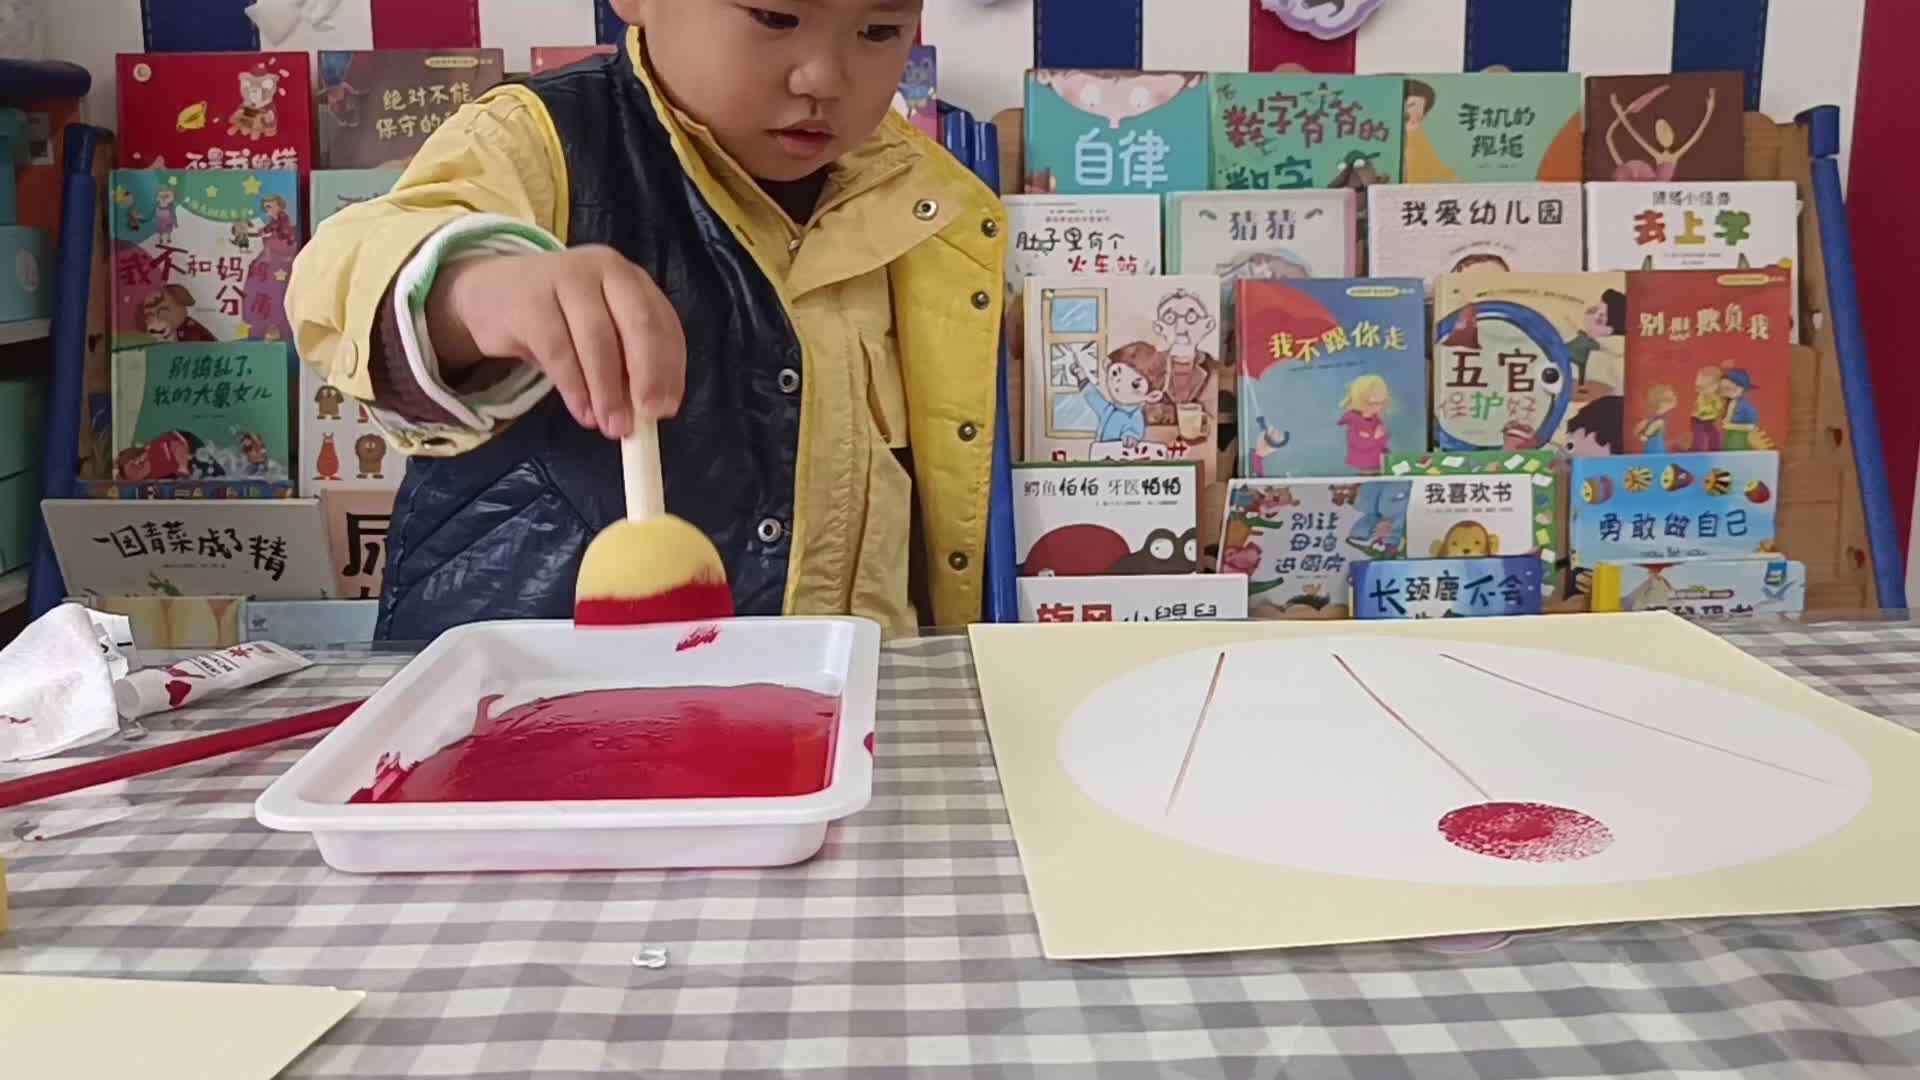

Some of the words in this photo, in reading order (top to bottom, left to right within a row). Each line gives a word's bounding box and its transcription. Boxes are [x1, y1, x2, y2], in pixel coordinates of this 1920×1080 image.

[383, 81, 473, 111] 绝对不能
[376, 113, 453, 139] 保守的
[1222, 91, 1391, 149] 数字爷爷的
[1457, 102, 1536, 131] 手机的
[1074, 128, 1170, 188] 自律
[1471, 133, 1524, 158] 规矩
[1229, 210, 1296, 241] 猜猜
[1401, 199, 1563, 226] 我爱幼儿园
[1015, 227, 1125, 252] 肚子里有个
[1634, 209, 1752, 246] 去上学
[1067, 253, 1138, 275] 火车站
[1638, 303, 1774, 342] 别想欺负我
[1269, 320, 1409, 363] 我不跟你走
[1446, 348, 1537, 392] 五官
[1440, 391, 1537, 420] 保护好
[1425, 482, 1513, 504] 我喜欢书
[1291, 511, 1339, 530] 别让
[1599, 509, 1748, 541] 勇敢做自己
[1289, 532, 1338, 552] 母鸡
[1275, 553, 1347, 574] 进厨房
[1369, 570, 1523, 614] 长颈鹿不会
